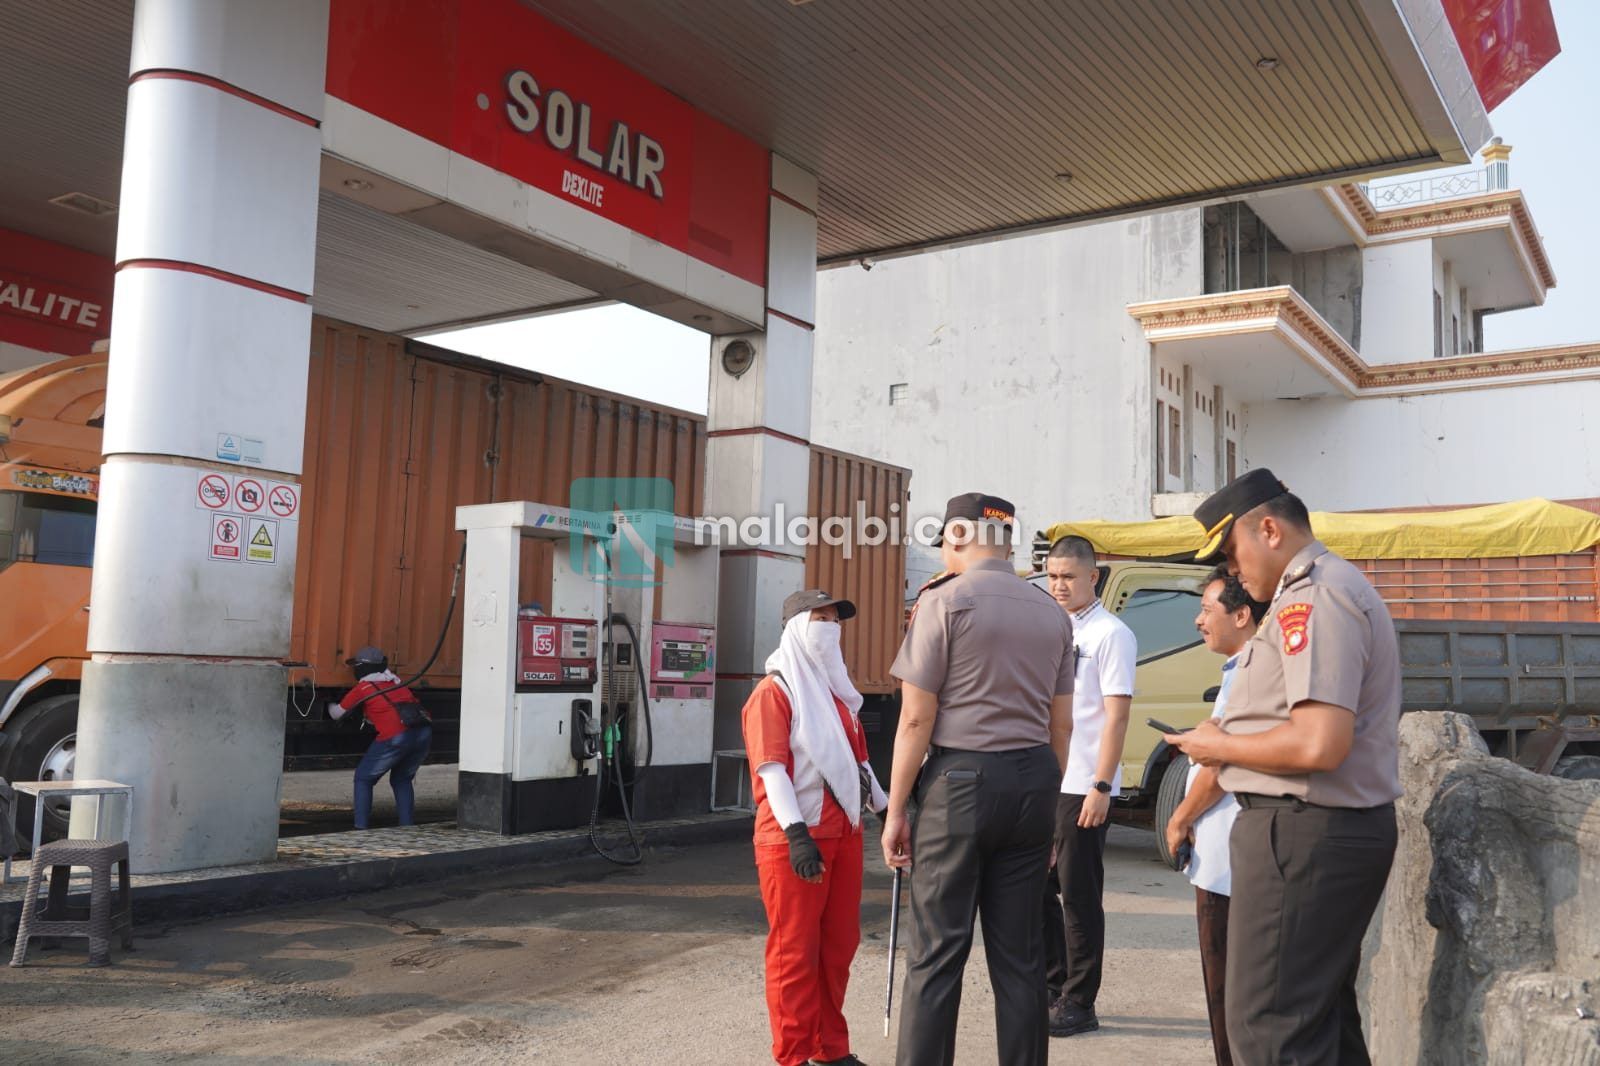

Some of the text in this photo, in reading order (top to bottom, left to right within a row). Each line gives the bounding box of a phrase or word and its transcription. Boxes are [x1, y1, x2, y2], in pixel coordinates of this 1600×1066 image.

[505, 70, 664, 198] SOLAR
[562, 170, 604, 208] DEXLITE
[0, 280, 102, 328] ALITE
[525, 672, 556, 680] SOLAR
